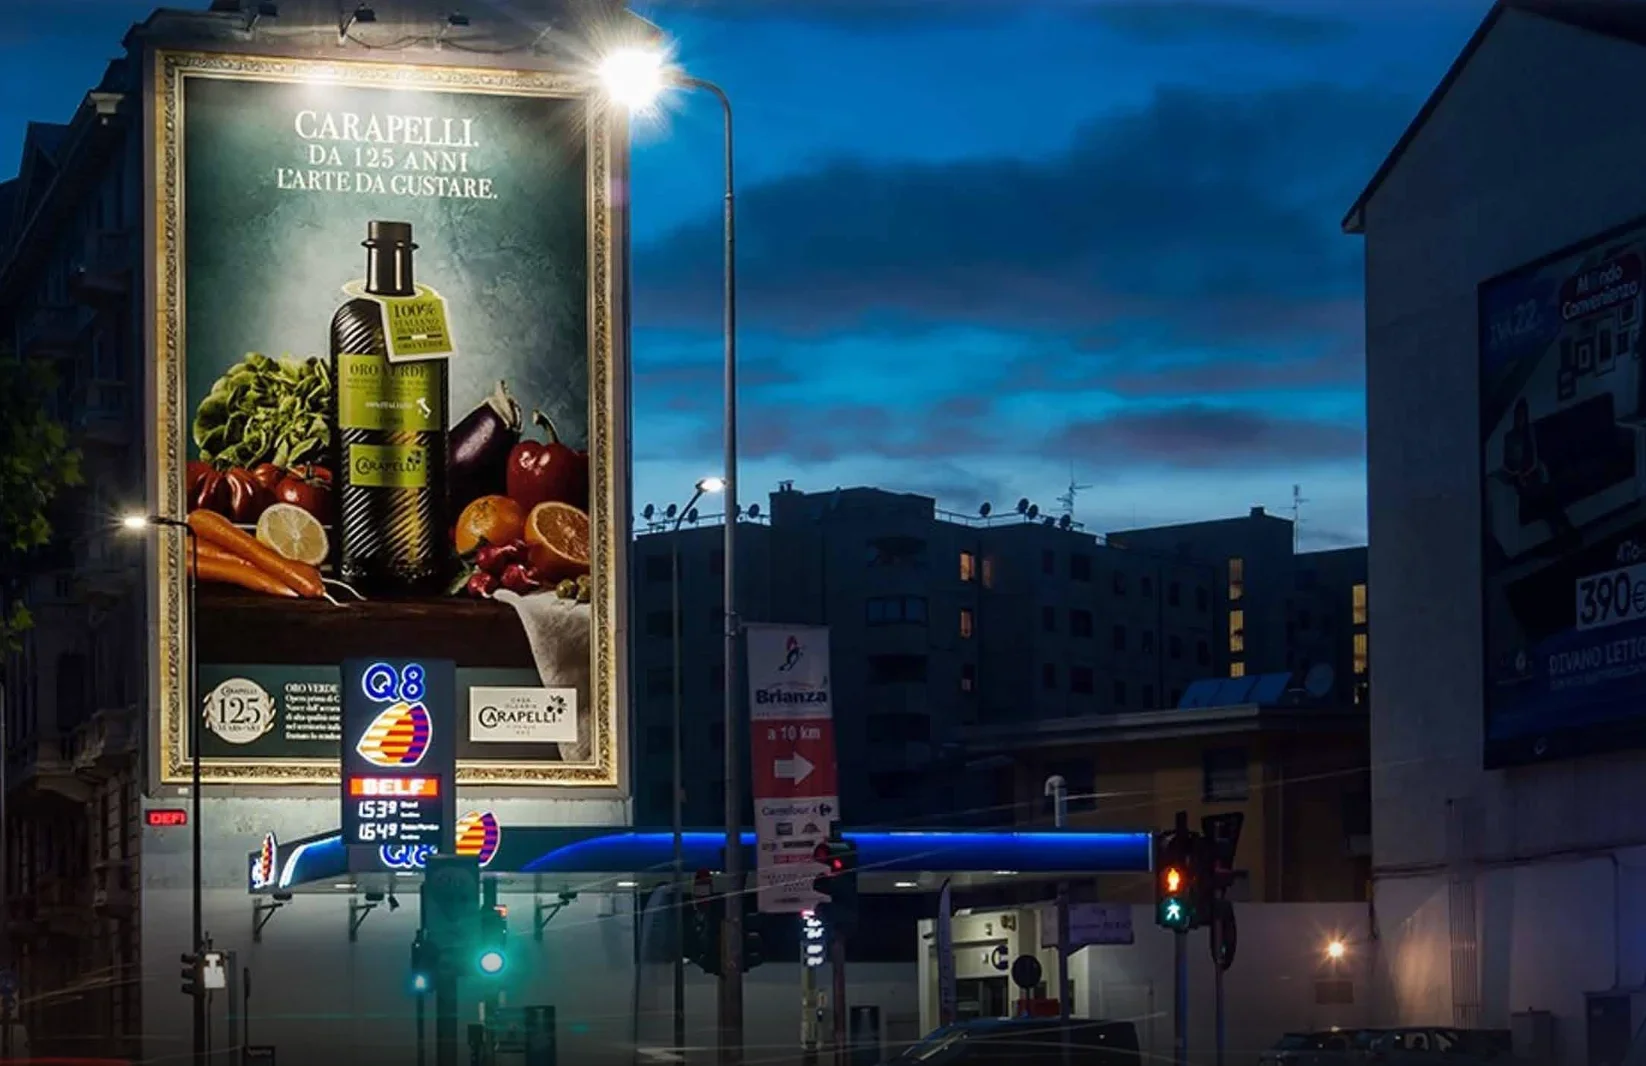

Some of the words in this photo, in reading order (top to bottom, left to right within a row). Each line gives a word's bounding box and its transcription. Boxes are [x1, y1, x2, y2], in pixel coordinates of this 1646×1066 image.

[295, 110, 480, 147] CARAPELLI.
[309, 144, 342, 166] DA
[355, 147, 395, 169] 125
[404, 151, 469, 173] ANNI
[277, 168, 351, 191] L'ARTE
[356, 172, 385, 193] DA
[390, 175, 498, 199] GUSTARE.
[393, 302, 436, 318] 100%
[350, 363, 378, 376] ORO
[382, 363, 428, 378] VRDE
[1580, 571, 1646, 626] 390€
[361, 662, 426, 702] Q8
[219, 697, 261, 724] 125
[756, 690, 827, 704] Brianza
[478, 706, 556, 728] CARAPELLI
[767, 727, 777, 741] a
[781, 724, 797, 741] 10
[800, 724, 821, 741] km
